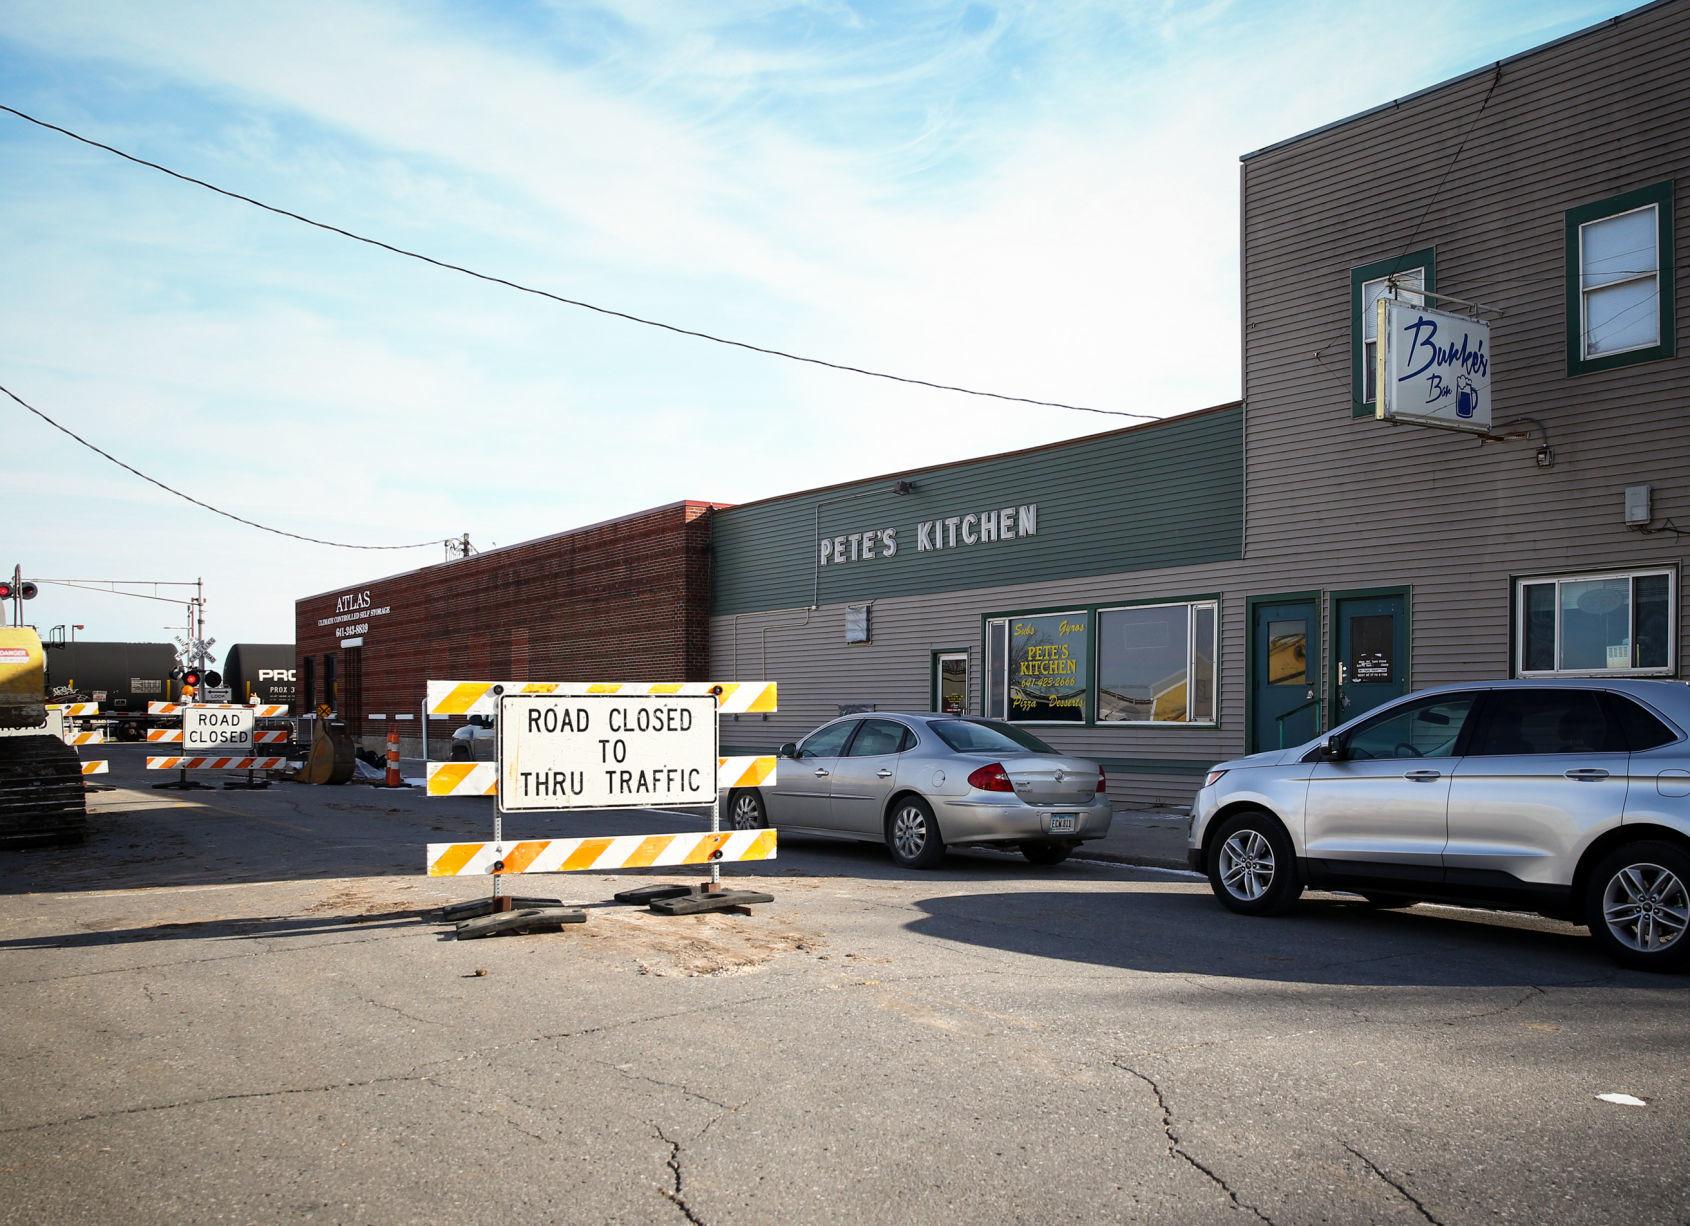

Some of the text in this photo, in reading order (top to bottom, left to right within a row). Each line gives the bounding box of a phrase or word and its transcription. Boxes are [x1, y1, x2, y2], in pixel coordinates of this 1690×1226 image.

[1425, 373, 1453, 404] Bar
[820, 503, 1038, 567] PETE'S KITCHEN
[336, 591, 370, 612] ATLAS
[359, 610, 371, 618] SELF
[370, 606, 391, 616] STORAGE
[1014, 620, 1085, 636] Subs Gyros
[1028, 643, 1069, 660] PETE'S
[1020, 660, 1076, 675] KITCHEN
[1012, 694, 1085, 711] Pizza Desserts
[199, 714, 240, 726] ROAD
[528, 708, 693, 733] ROAD CLOSED
[190, 731, 248, 743] CLOSED
[598, 739, 627, 763] TO
[520, 768, 701, 797] THRU TRAFFIC
